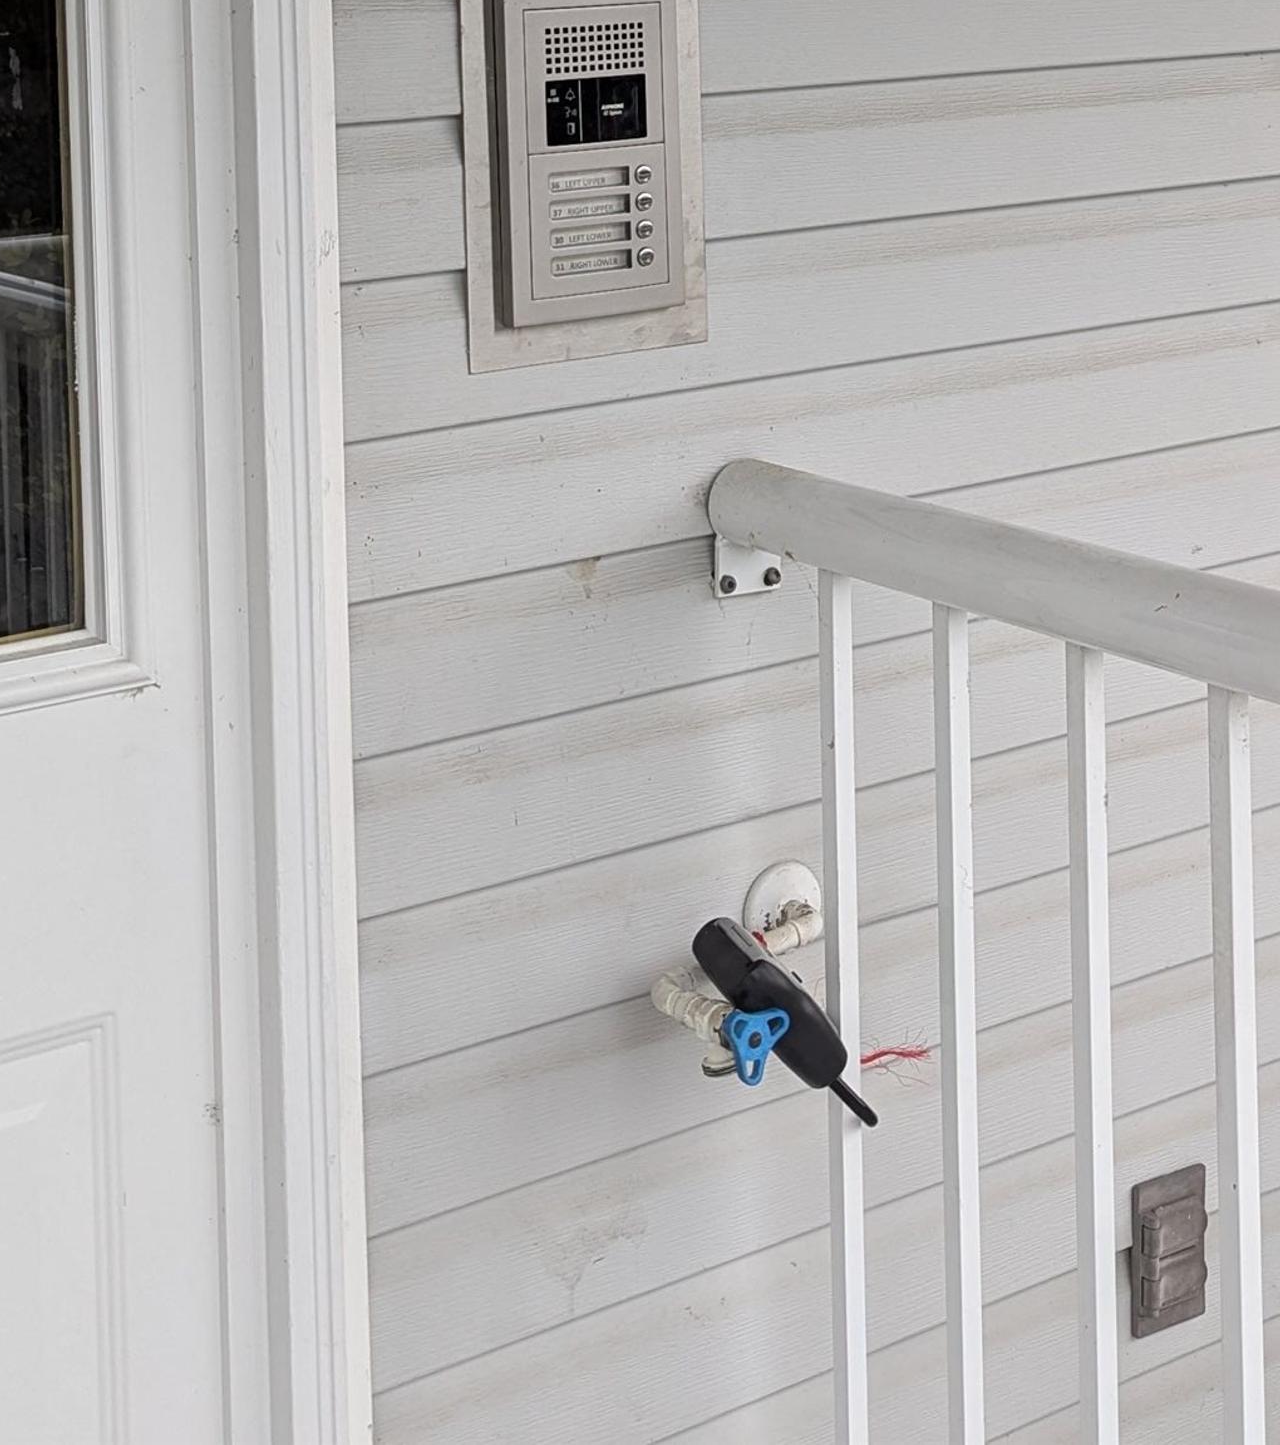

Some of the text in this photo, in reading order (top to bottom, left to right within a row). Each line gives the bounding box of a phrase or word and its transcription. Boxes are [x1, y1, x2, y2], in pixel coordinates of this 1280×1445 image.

[565, 178, 582, 188] LEFT
[553, 204, 613, 217] 37 RIGHT UPPER
[569, 233, 585, 243] LEFT
[586, 231, 611, 241] LOWER
[555, 257, 618, 271] 31 RIGHT LOWER
